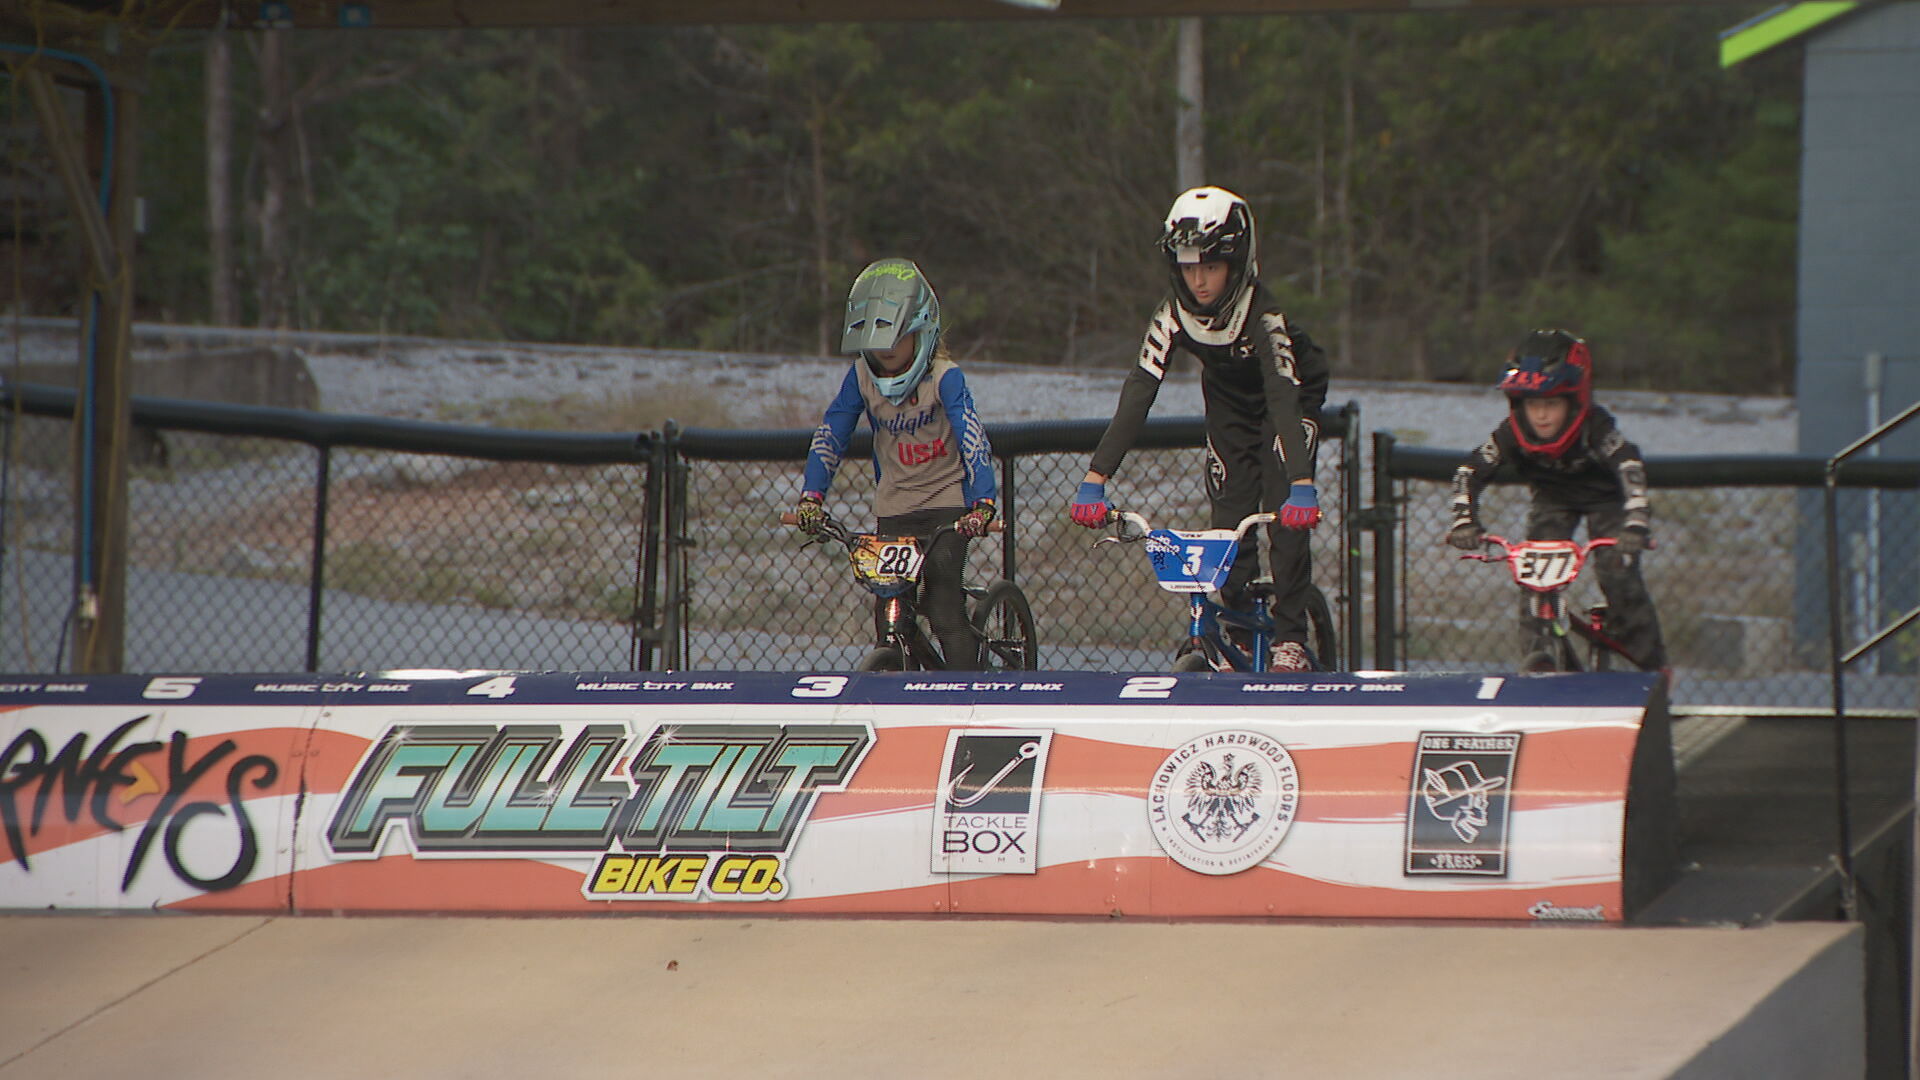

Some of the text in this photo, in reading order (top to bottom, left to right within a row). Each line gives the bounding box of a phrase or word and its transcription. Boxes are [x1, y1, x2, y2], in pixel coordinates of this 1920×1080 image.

[898, 437, 948, 466] USA
[879, 546, 912, 575] 28
[1181, 545, 1205, 576] 3
[1520, 552, 1572, 580] 377
[45, 684, 88, 693] BMX
[141, 677, 203, 699] 5
[254, 682, 411, 694] MUSIC CITY BMX
[466, 676, 517, 699] 4
[576, 681, 734, 692] MUSIC CITY BMX
[791, 676, 849, 699] 3
[903, 682, 1064, 692] MUSIC CITY BMX
[1118, 676, 1178, 699] 2
[1242, 683, 1405, 692] MUSIC CITY BMX
[1476, 677, 1505, 700] 1
[1424, 738, 1515, 750] ONE FEATHER
[334, 731, 864, 847] FULL TILT
[1153, 734, 1294, 823] LACHOWICZ HARDWOOD FLOORS
[943, 816, 1027, 829] TACKLE
[942, 831, 1026, 854] BOX
[589, 854, 783, 894] BIKE CO.
